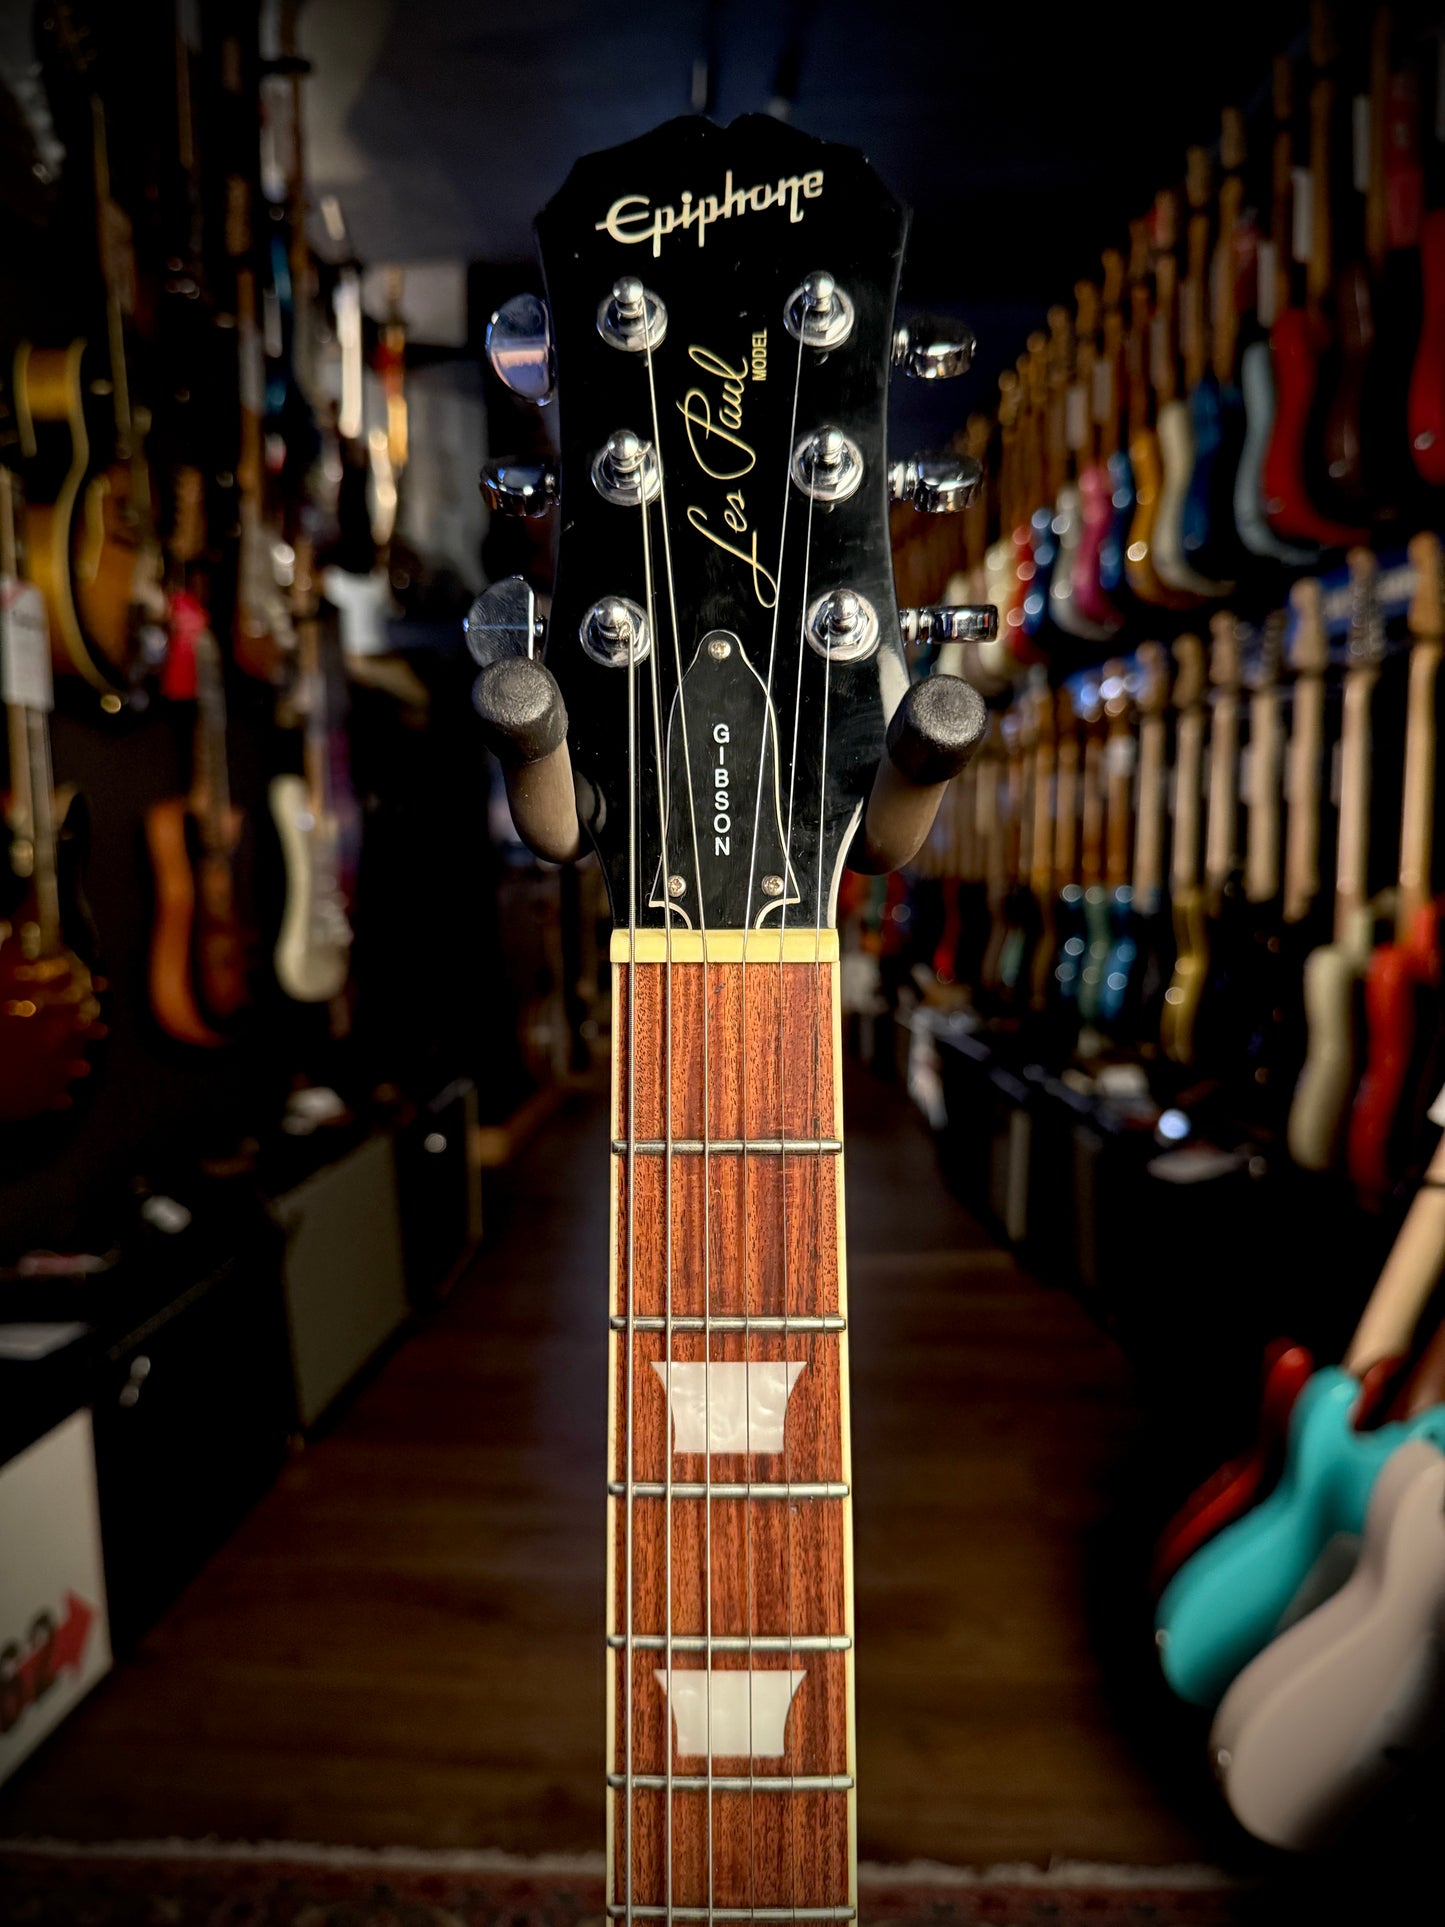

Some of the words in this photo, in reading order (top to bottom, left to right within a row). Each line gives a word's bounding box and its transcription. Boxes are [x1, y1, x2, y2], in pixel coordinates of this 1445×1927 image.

[595, 169, 824, 258] Epiphone
[676, 344, 756, 480] Paul
[752, 327, 767, 381] MODEL
[687, 489, 778, 608] Les
[713, 723, 731, 856] GIBSON
